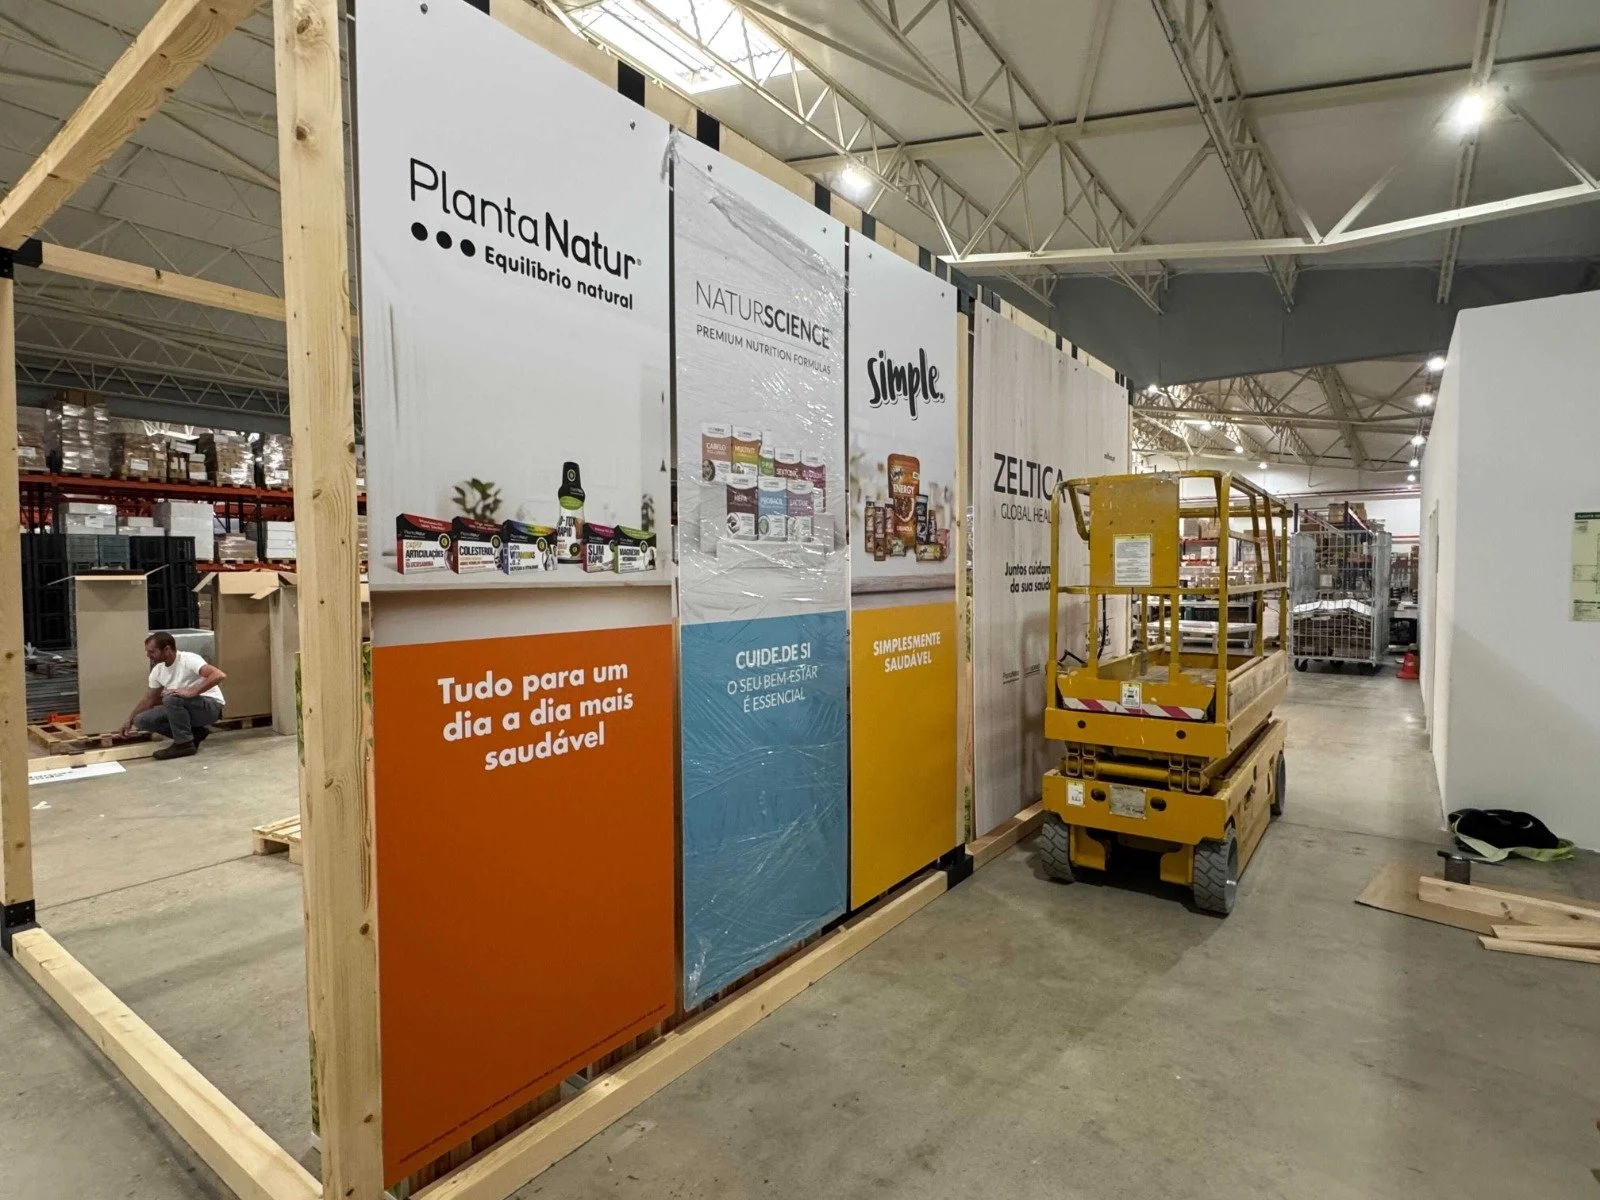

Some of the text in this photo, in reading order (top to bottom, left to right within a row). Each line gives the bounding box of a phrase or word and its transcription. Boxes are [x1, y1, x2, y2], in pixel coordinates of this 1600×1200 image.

[410, 157, 636, 280] PlantaNatur
[486, 245, 633, 311] Equilíbrio natural
[696, 280, 831, 350] NATURSCIENCE
[696, 324, 831, 375] PREMIUM NUTRITION FORMULAS
[993, 452, 1067, 504] ZELTICA
[1000, 503, 1053, 524] GLOBAL HEAL
[459, 545, 495, 556] COLESTEROL
[588, 544, 605, 556] SLIM
[1004, 560, 1051, 576] Juntos cuidam
[1010, 577, 1051, 593] da sua saúd
[735, 642, 811, 670] CUIDE DE SI
[873, 631, 941, 656] SIMPLESMENTE
[884, 649, 932, 673] SAUDÁVEL
[437, 663, 628, 705] Tudo para um
[727, 665, 818, 695] O SEU BEM-ESTAR
[442, 687, 634, 742] dia a dia mais
[743, 687, 806, 713] É ESSENCIAL
[484, 720, 605, 771] saudável
